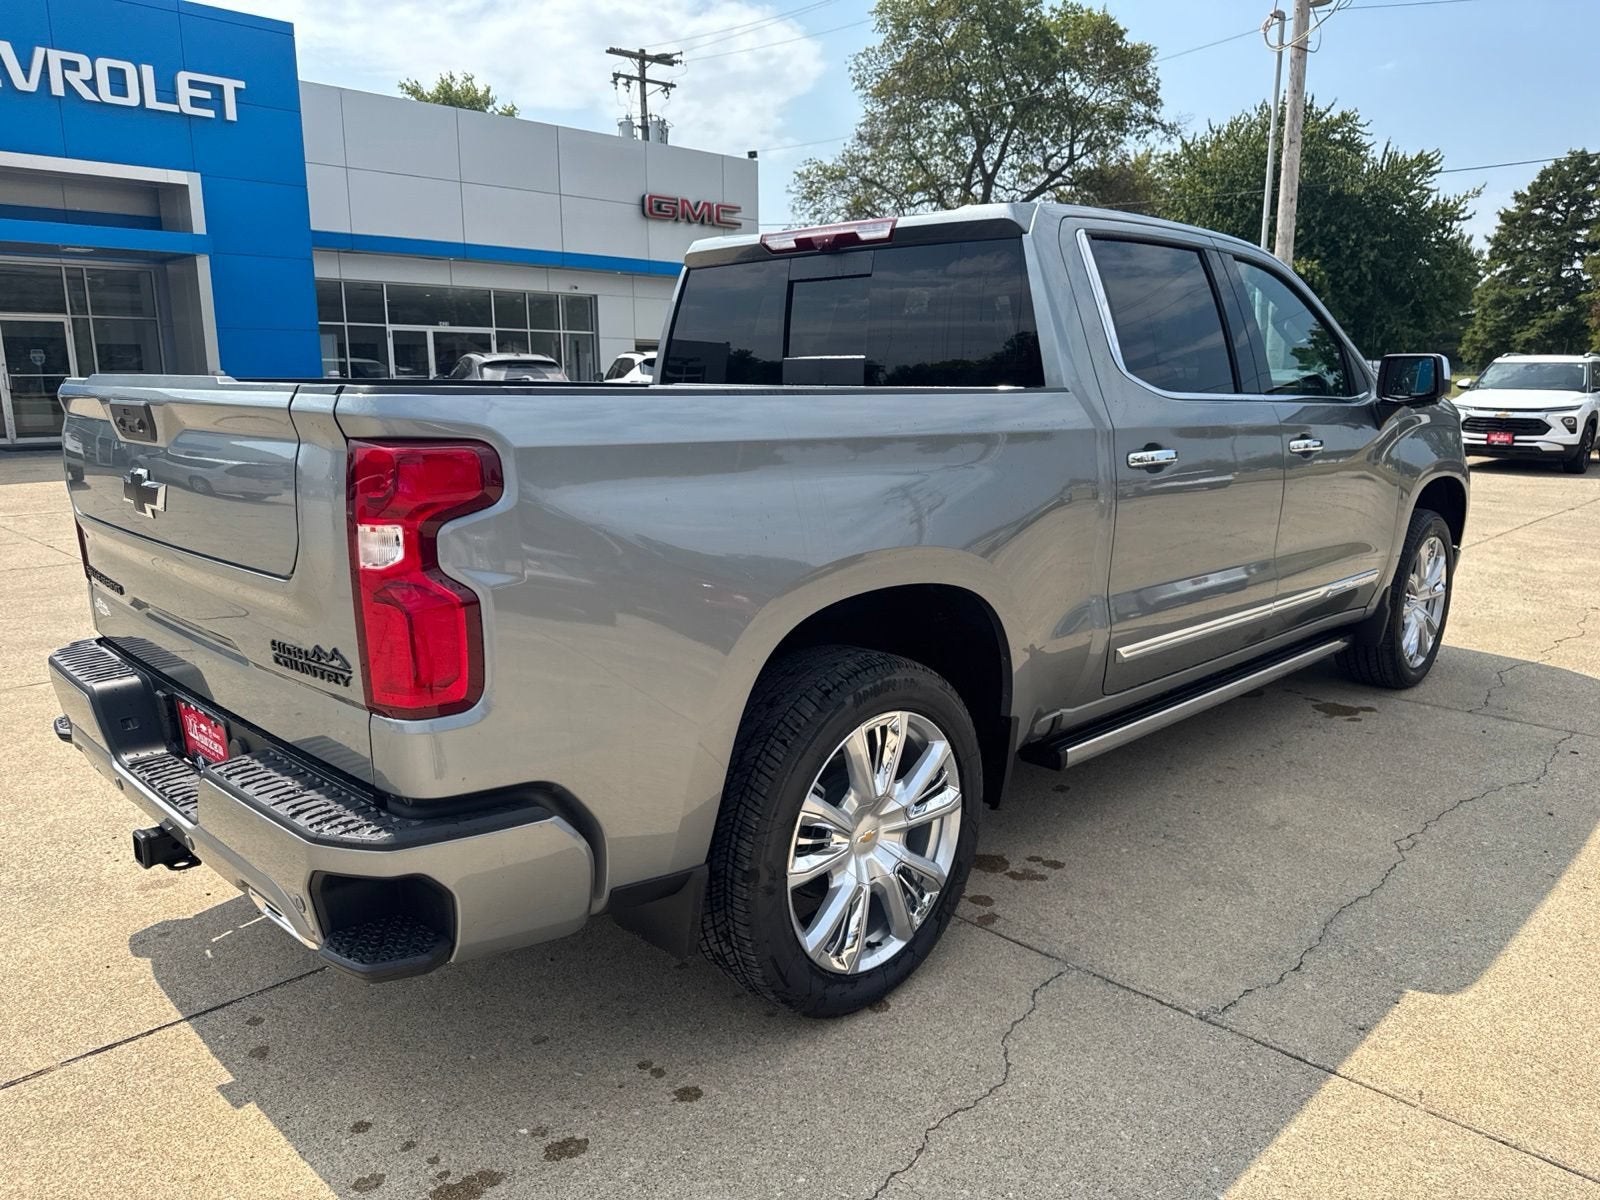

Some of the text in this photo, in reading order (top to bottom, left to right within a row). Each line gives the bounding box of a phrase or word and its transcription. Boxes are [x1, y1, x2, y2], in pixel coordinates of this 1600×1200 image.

[0, 40, 247, 122] VROLET
[641, 193, 742, 229] GMC
[270, 639, 309, 661] HIGH
[271, 652, 353, 687] COUNTRY
